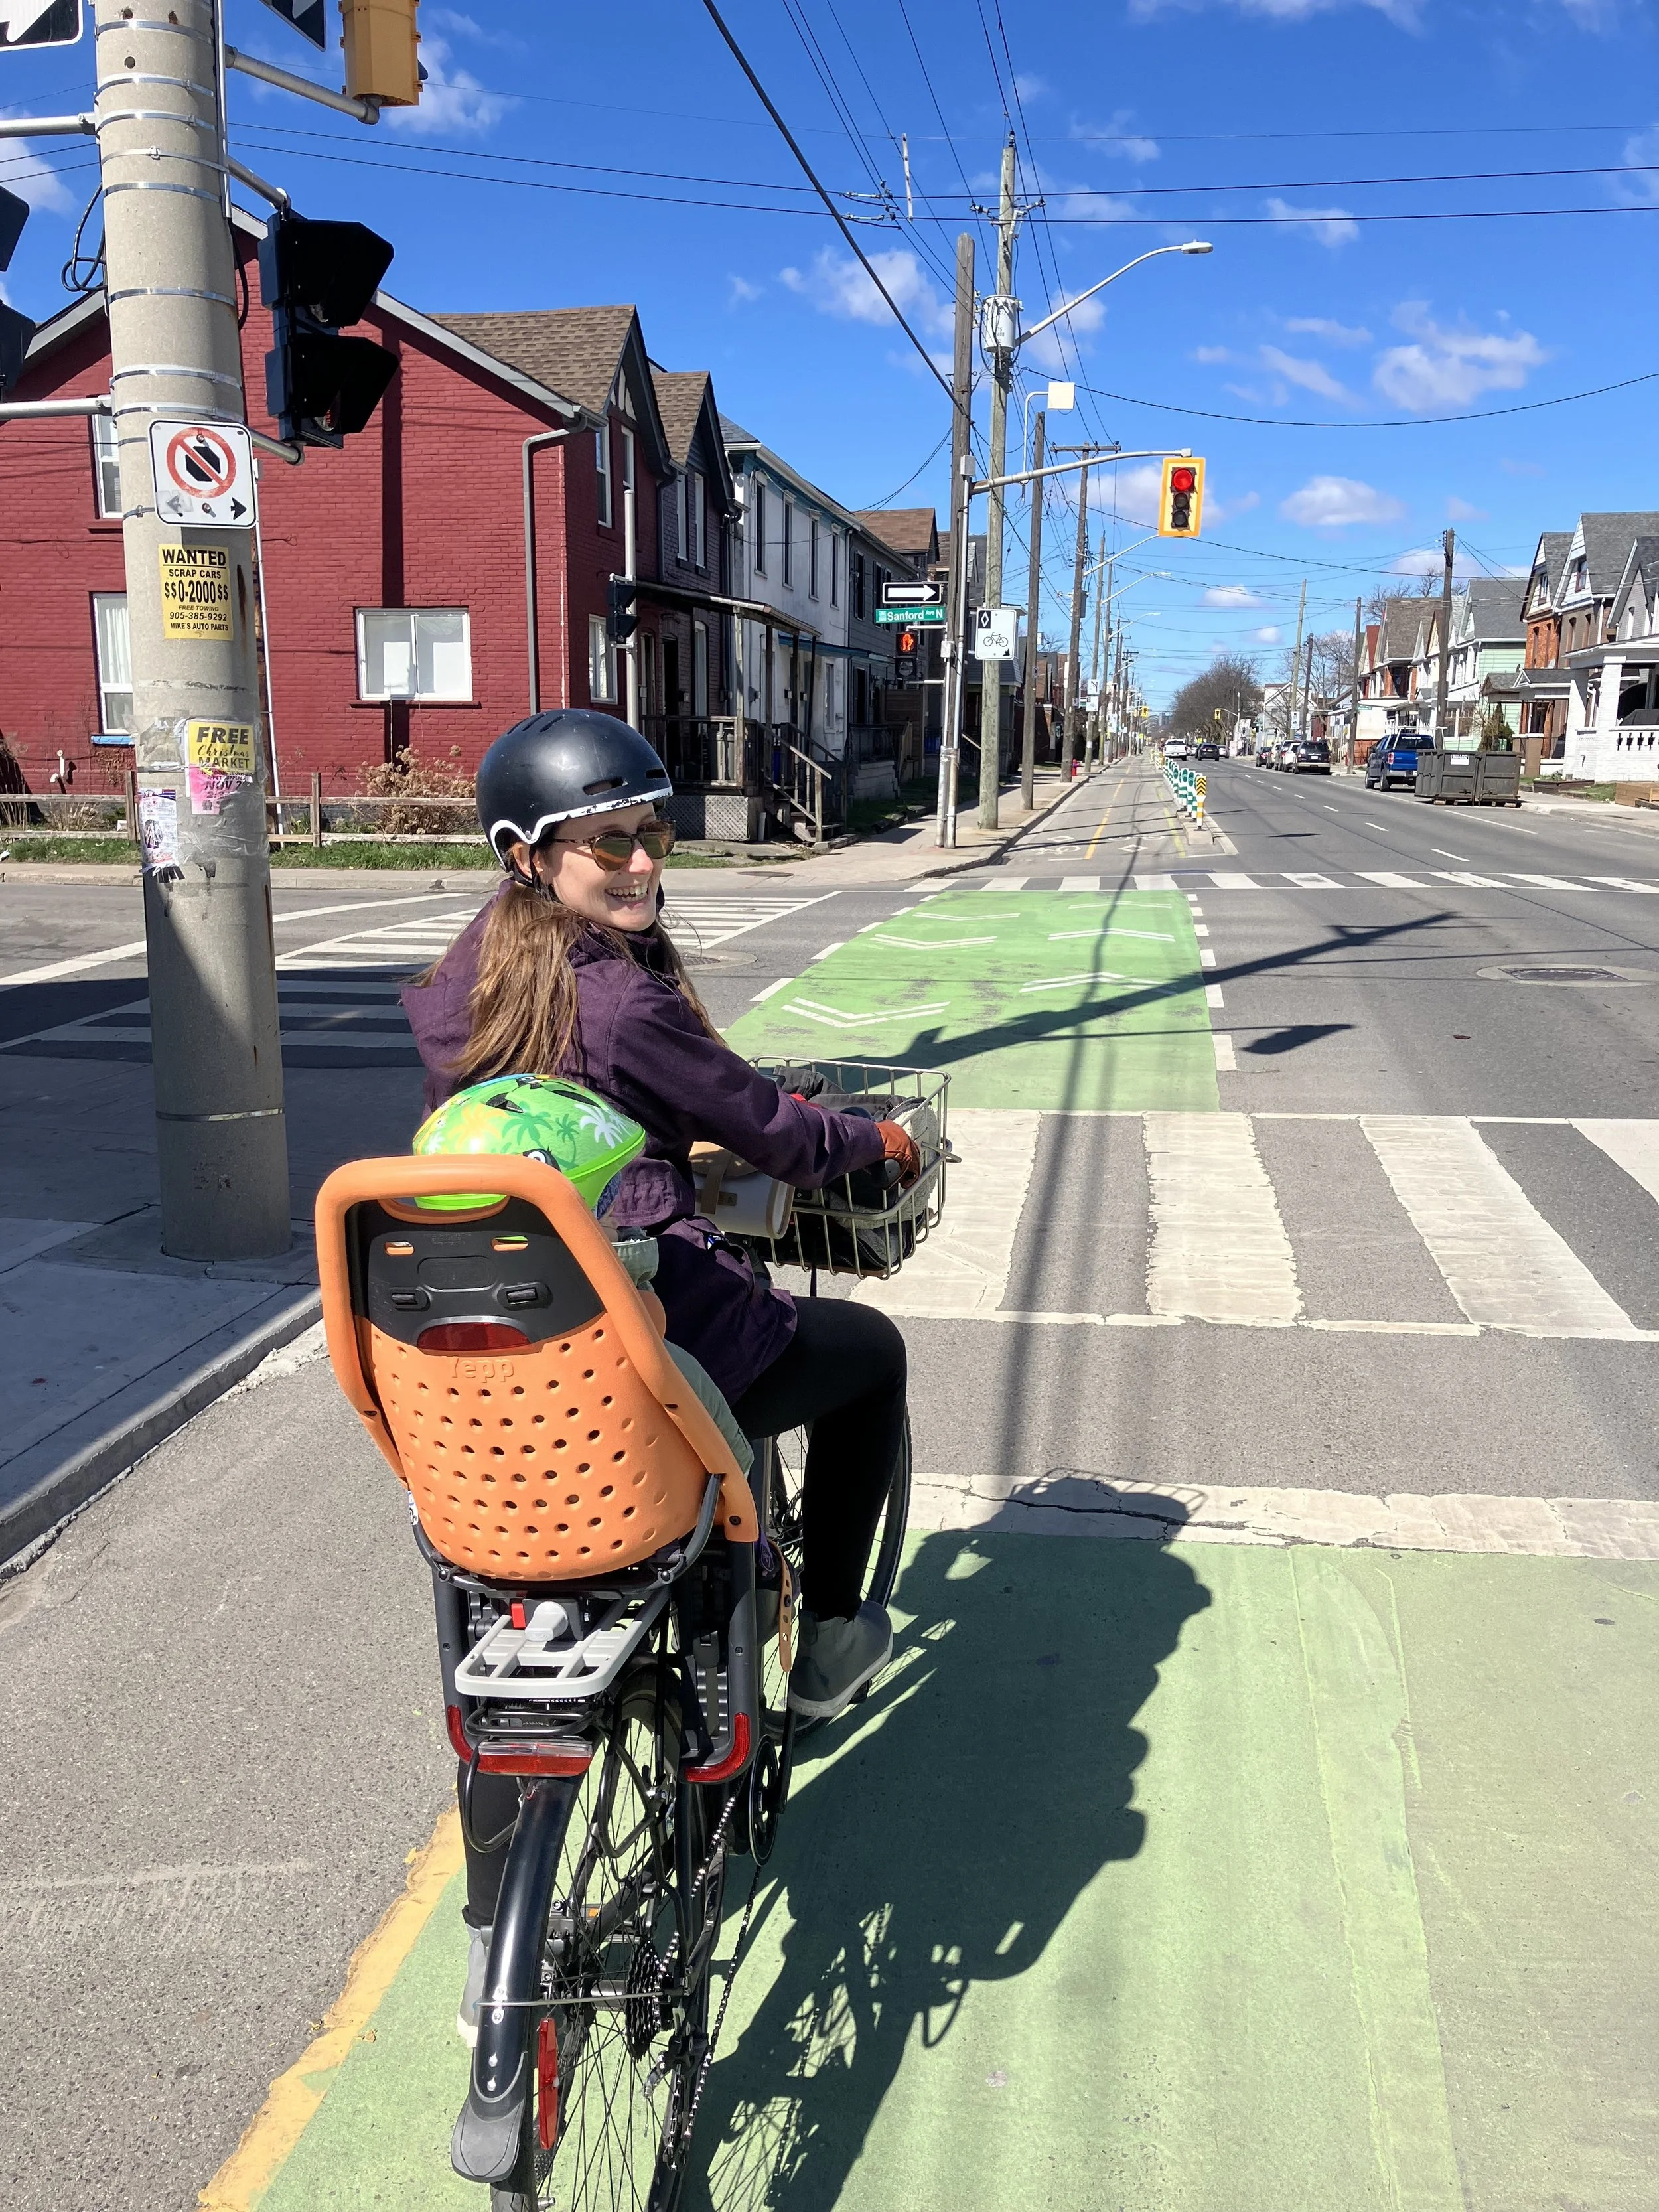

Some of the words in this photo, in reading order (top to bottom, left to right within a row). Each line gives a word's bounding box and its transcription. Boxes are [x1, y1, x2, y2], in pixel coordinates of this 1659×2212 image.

[162, 549, 226, 566] WANTED
[200, 570, 222, 579] CARS
[169, 611, 227, 621] 905-385-9292
[887, 610, 924, 621] Sanford
[936, 609, 943, 619] N
[196, 727, 250, 745] FREE
[197, 744, 250, 758] Christmas
[198, 757, 250, 769] MARKET
[204, 780, 233, 790] NOV
